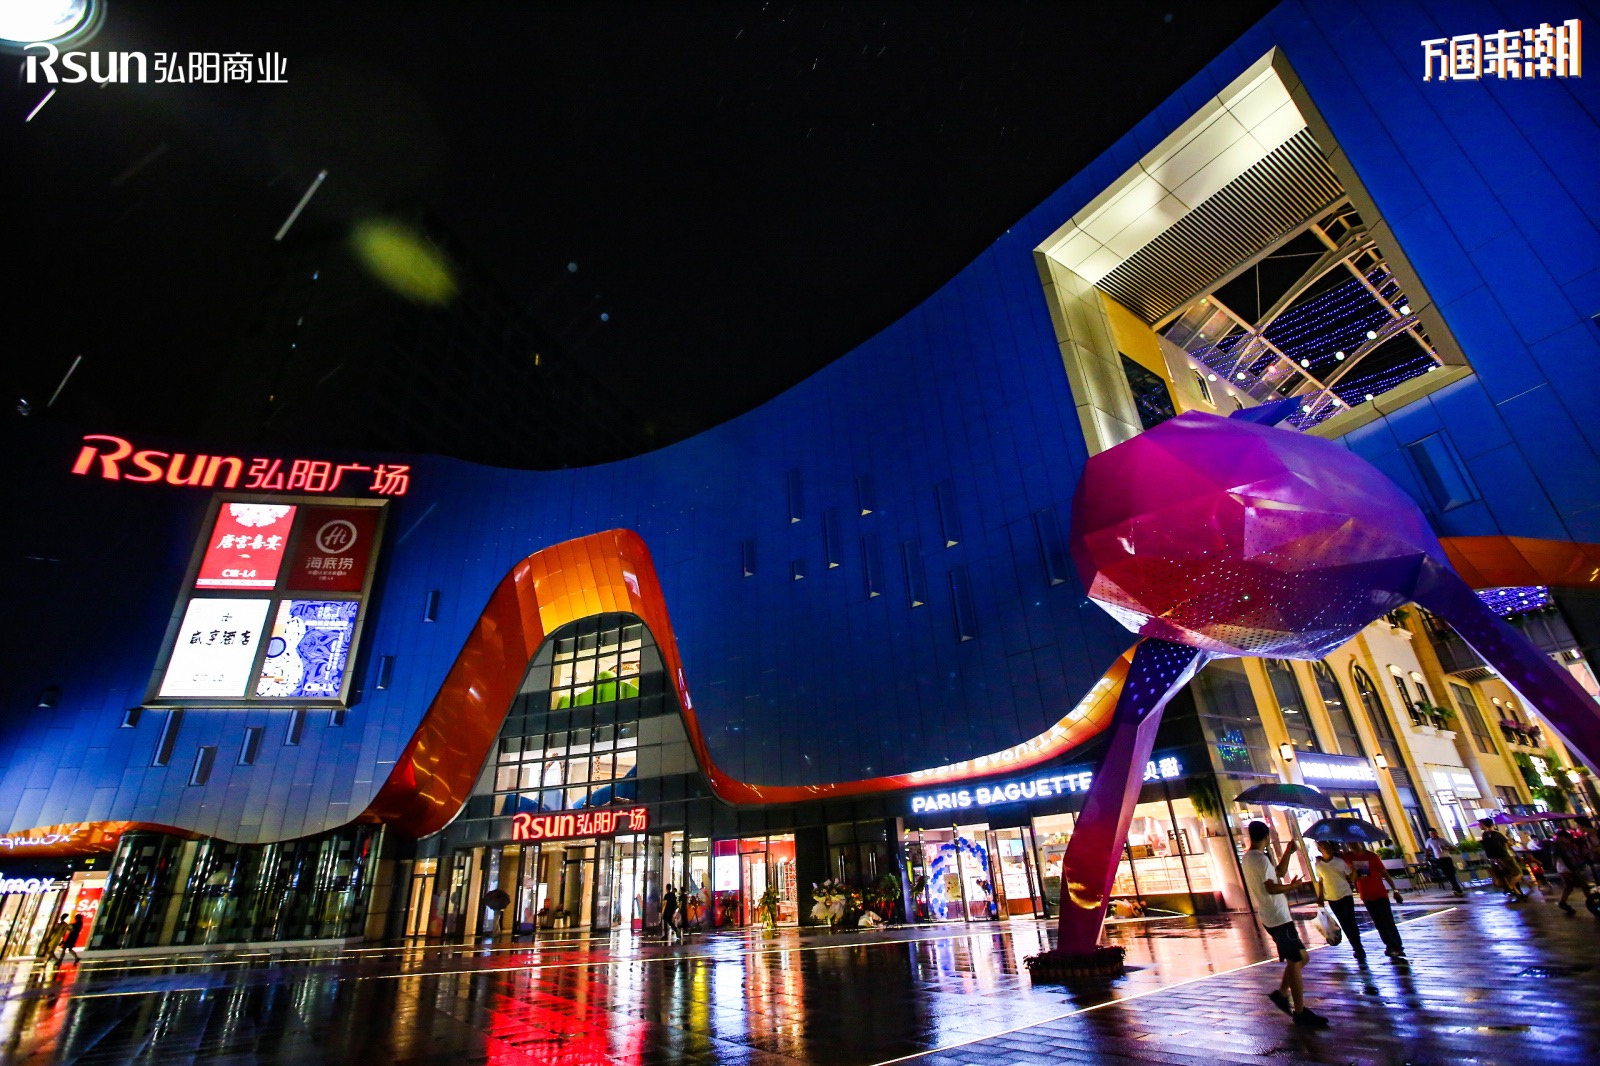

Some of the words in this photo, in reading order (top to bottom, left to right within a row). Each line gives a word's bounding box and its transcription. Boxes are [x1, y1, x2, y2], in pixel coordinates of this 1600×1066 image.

[72, 434, 243, 488] Rsun
[245, 458, 411, 496] 弘阳广场
[305, 557, 354, 570] 海底捞
[912, 792, 972, 813] PARIS
[977, 771, 1092, 805] BAGUETTE
[513, 813, 575, 840] Rsun
[576, 808, 647, 836] 弘阳广场
